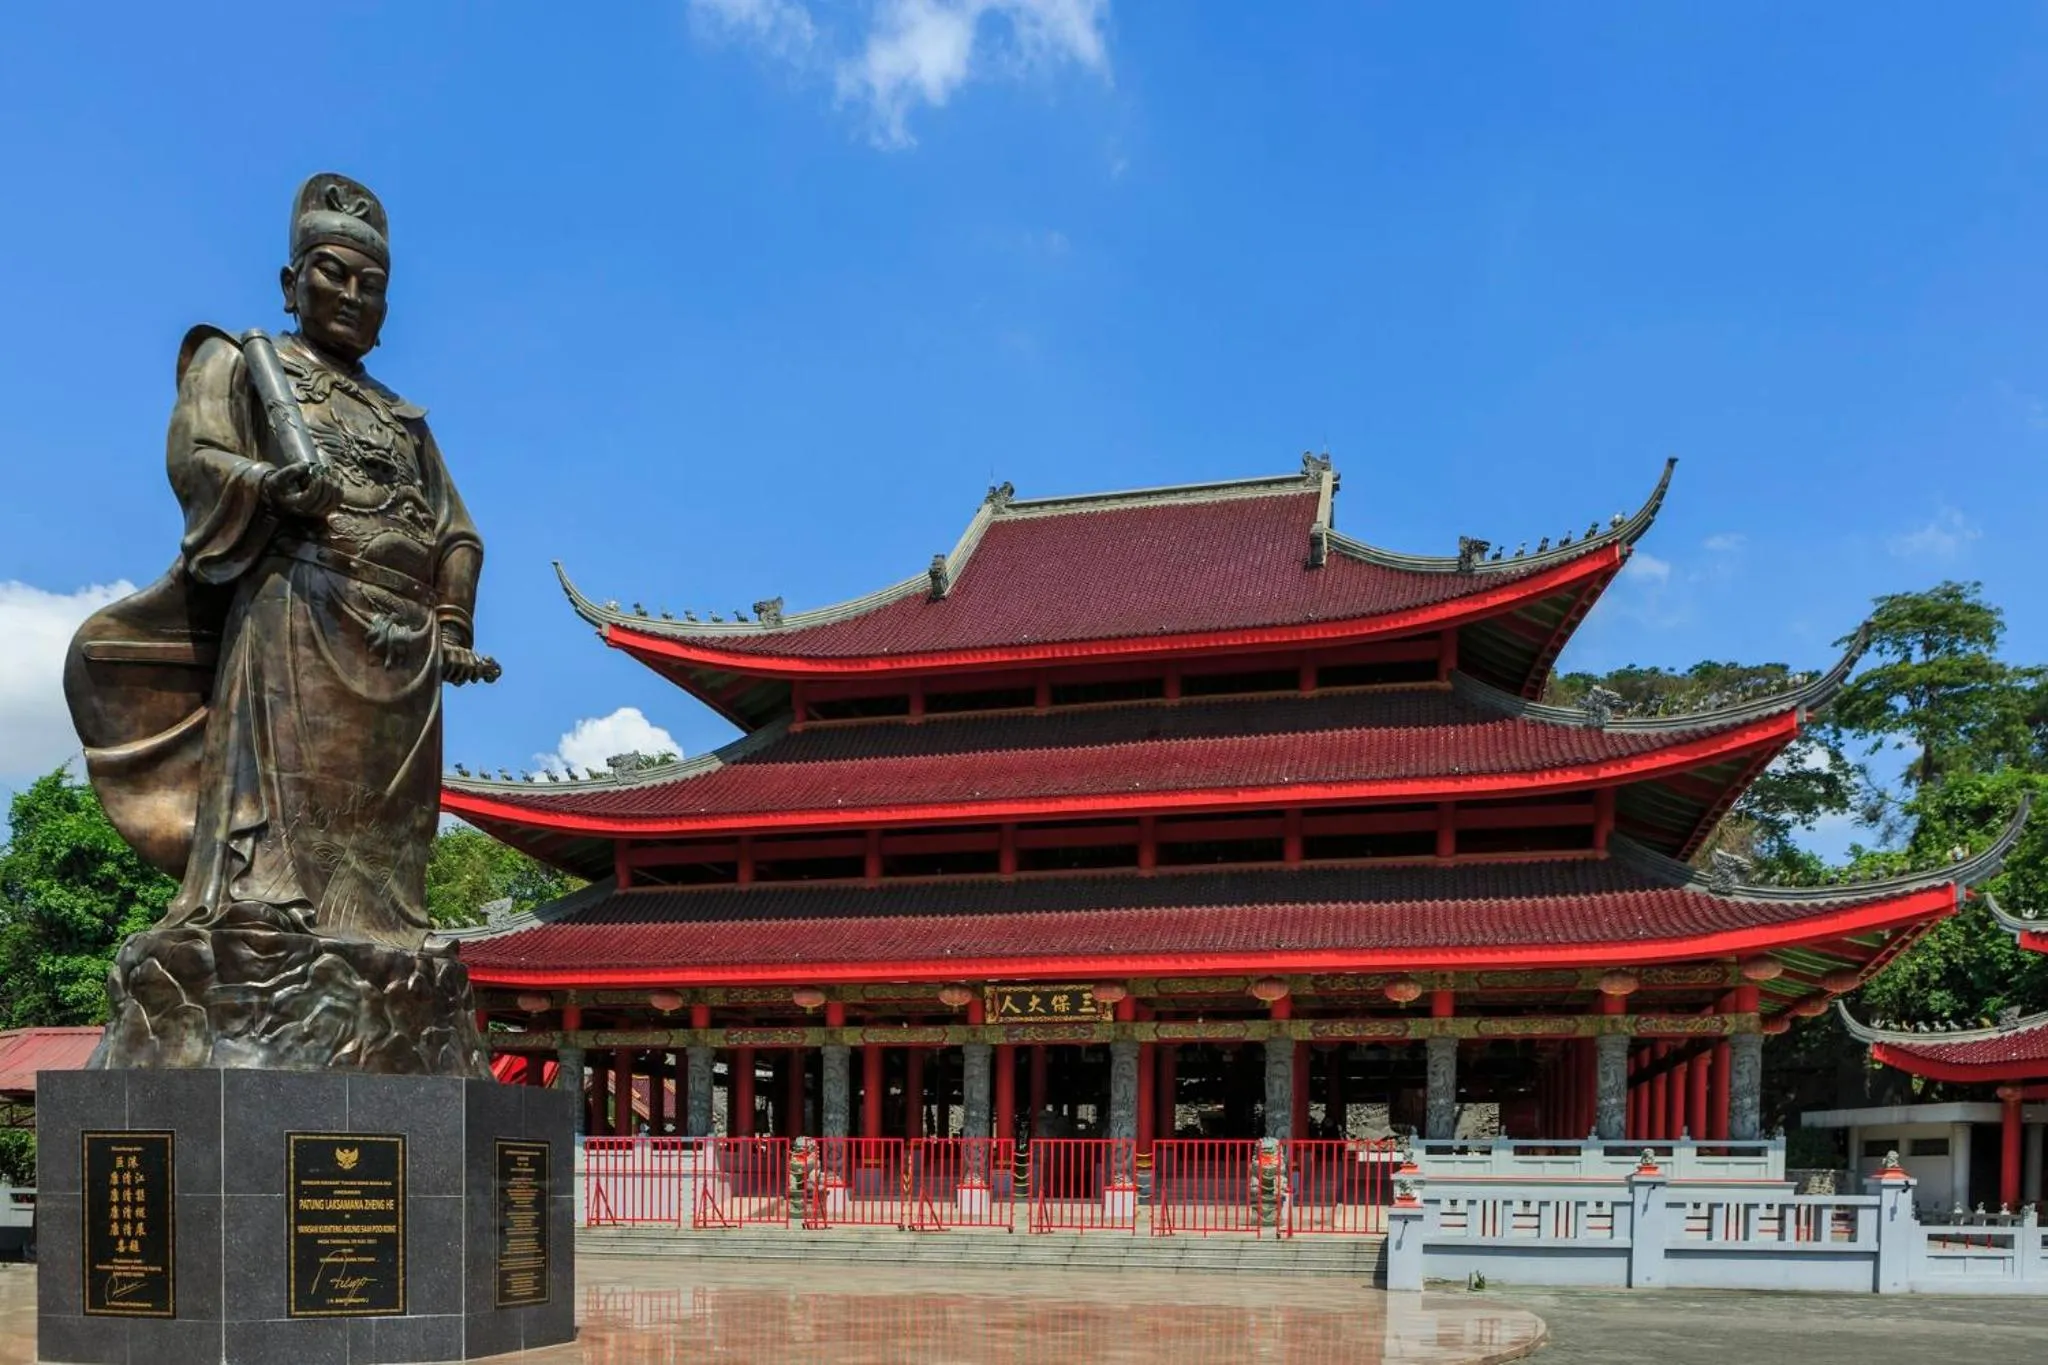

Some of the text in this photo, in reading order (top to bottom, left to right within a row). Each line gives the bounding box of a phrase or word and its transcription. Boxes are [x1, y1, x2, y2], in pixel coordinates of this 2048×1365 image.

[299, 1199, 395, 1210] PATUNG LAKSAMANA ZHENG HE
